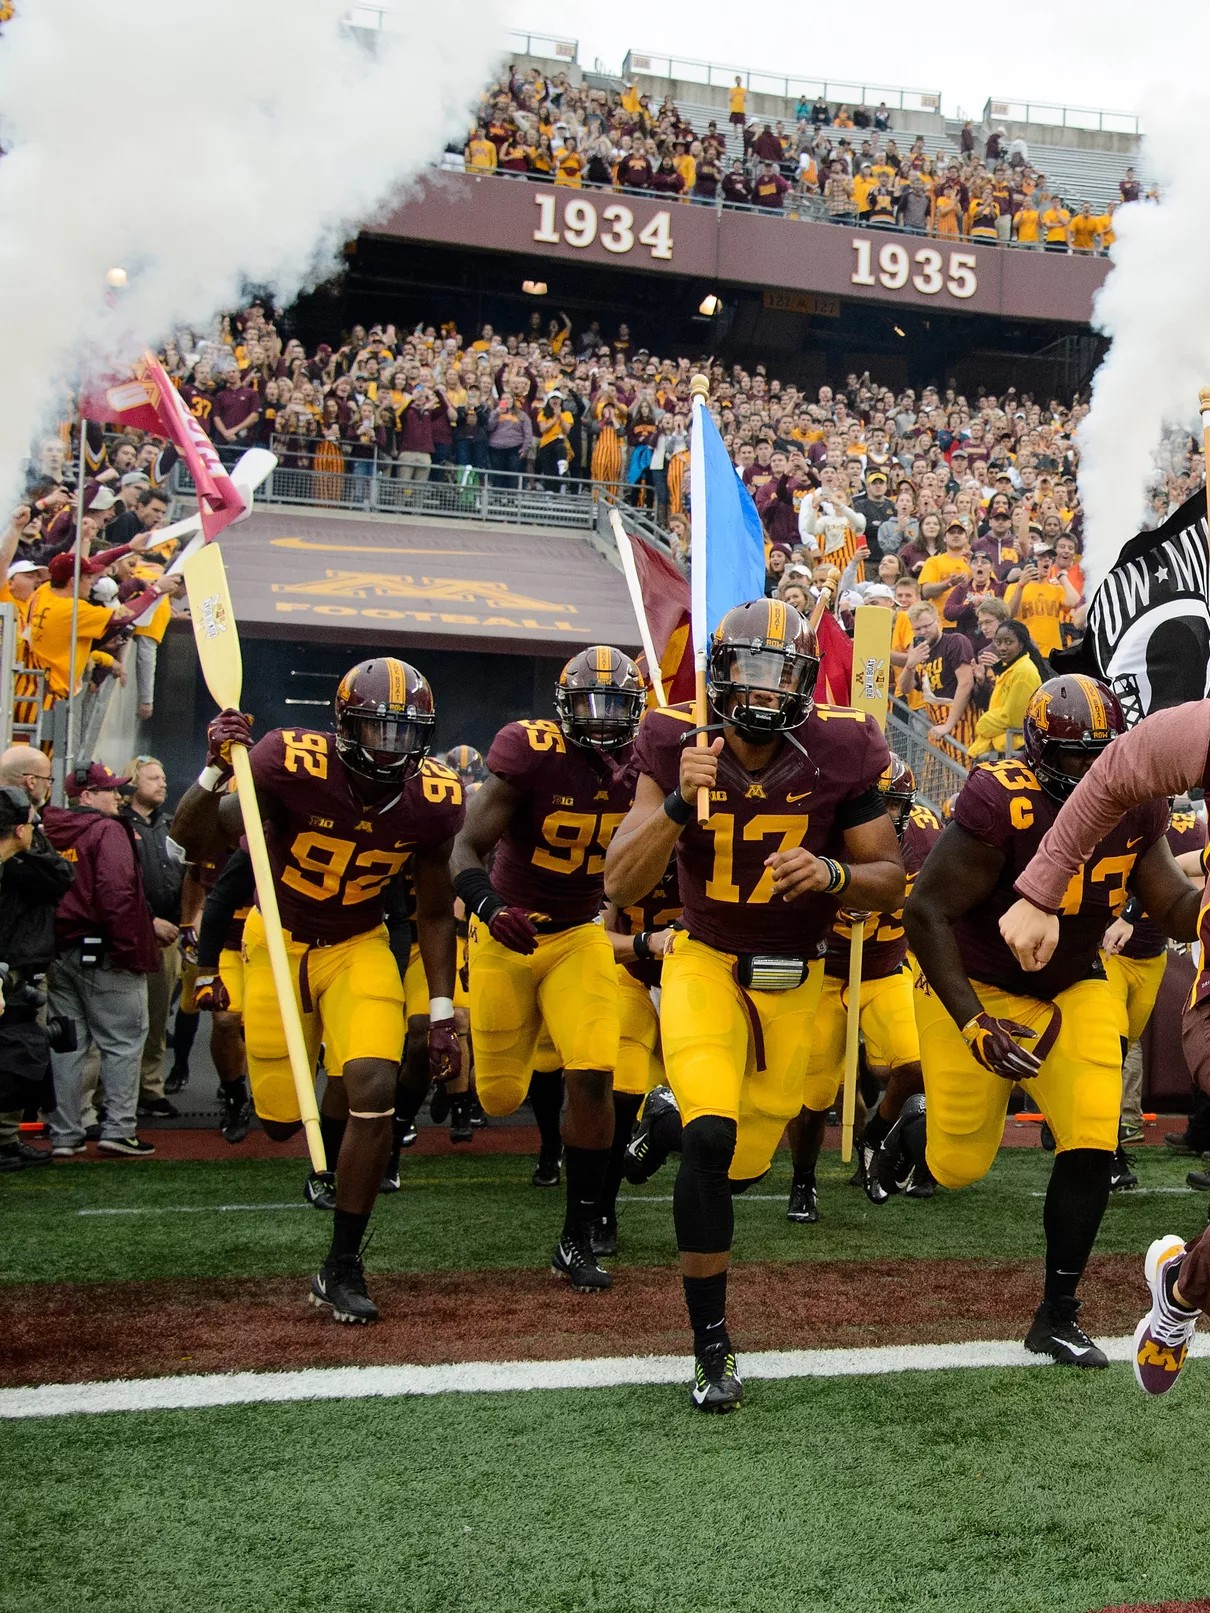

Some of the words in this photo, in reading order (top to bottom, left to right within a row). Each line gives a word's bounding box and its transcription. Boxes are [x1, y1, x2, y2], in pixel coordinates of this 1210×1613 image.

[532, 192, 674, 260] 1934
[851, 238, 978, 299] 1935
[190, 396, 213, 419] 37
[275, 602, 592, 633] FOOTBALL
[767, 639, 784, 649] ROW
[866, 659, 874, 676] BOAT
[389, 703, 406, 712] ROW
[517, 719, 567, 754] 95
[1092, 732, 1108, 740] ROW
[281, 730, 328, 780] 92
[1009, 796, 1035, 830] C
[280, 831, 414, 906] 92
[702, 813, 809, 904] 17
